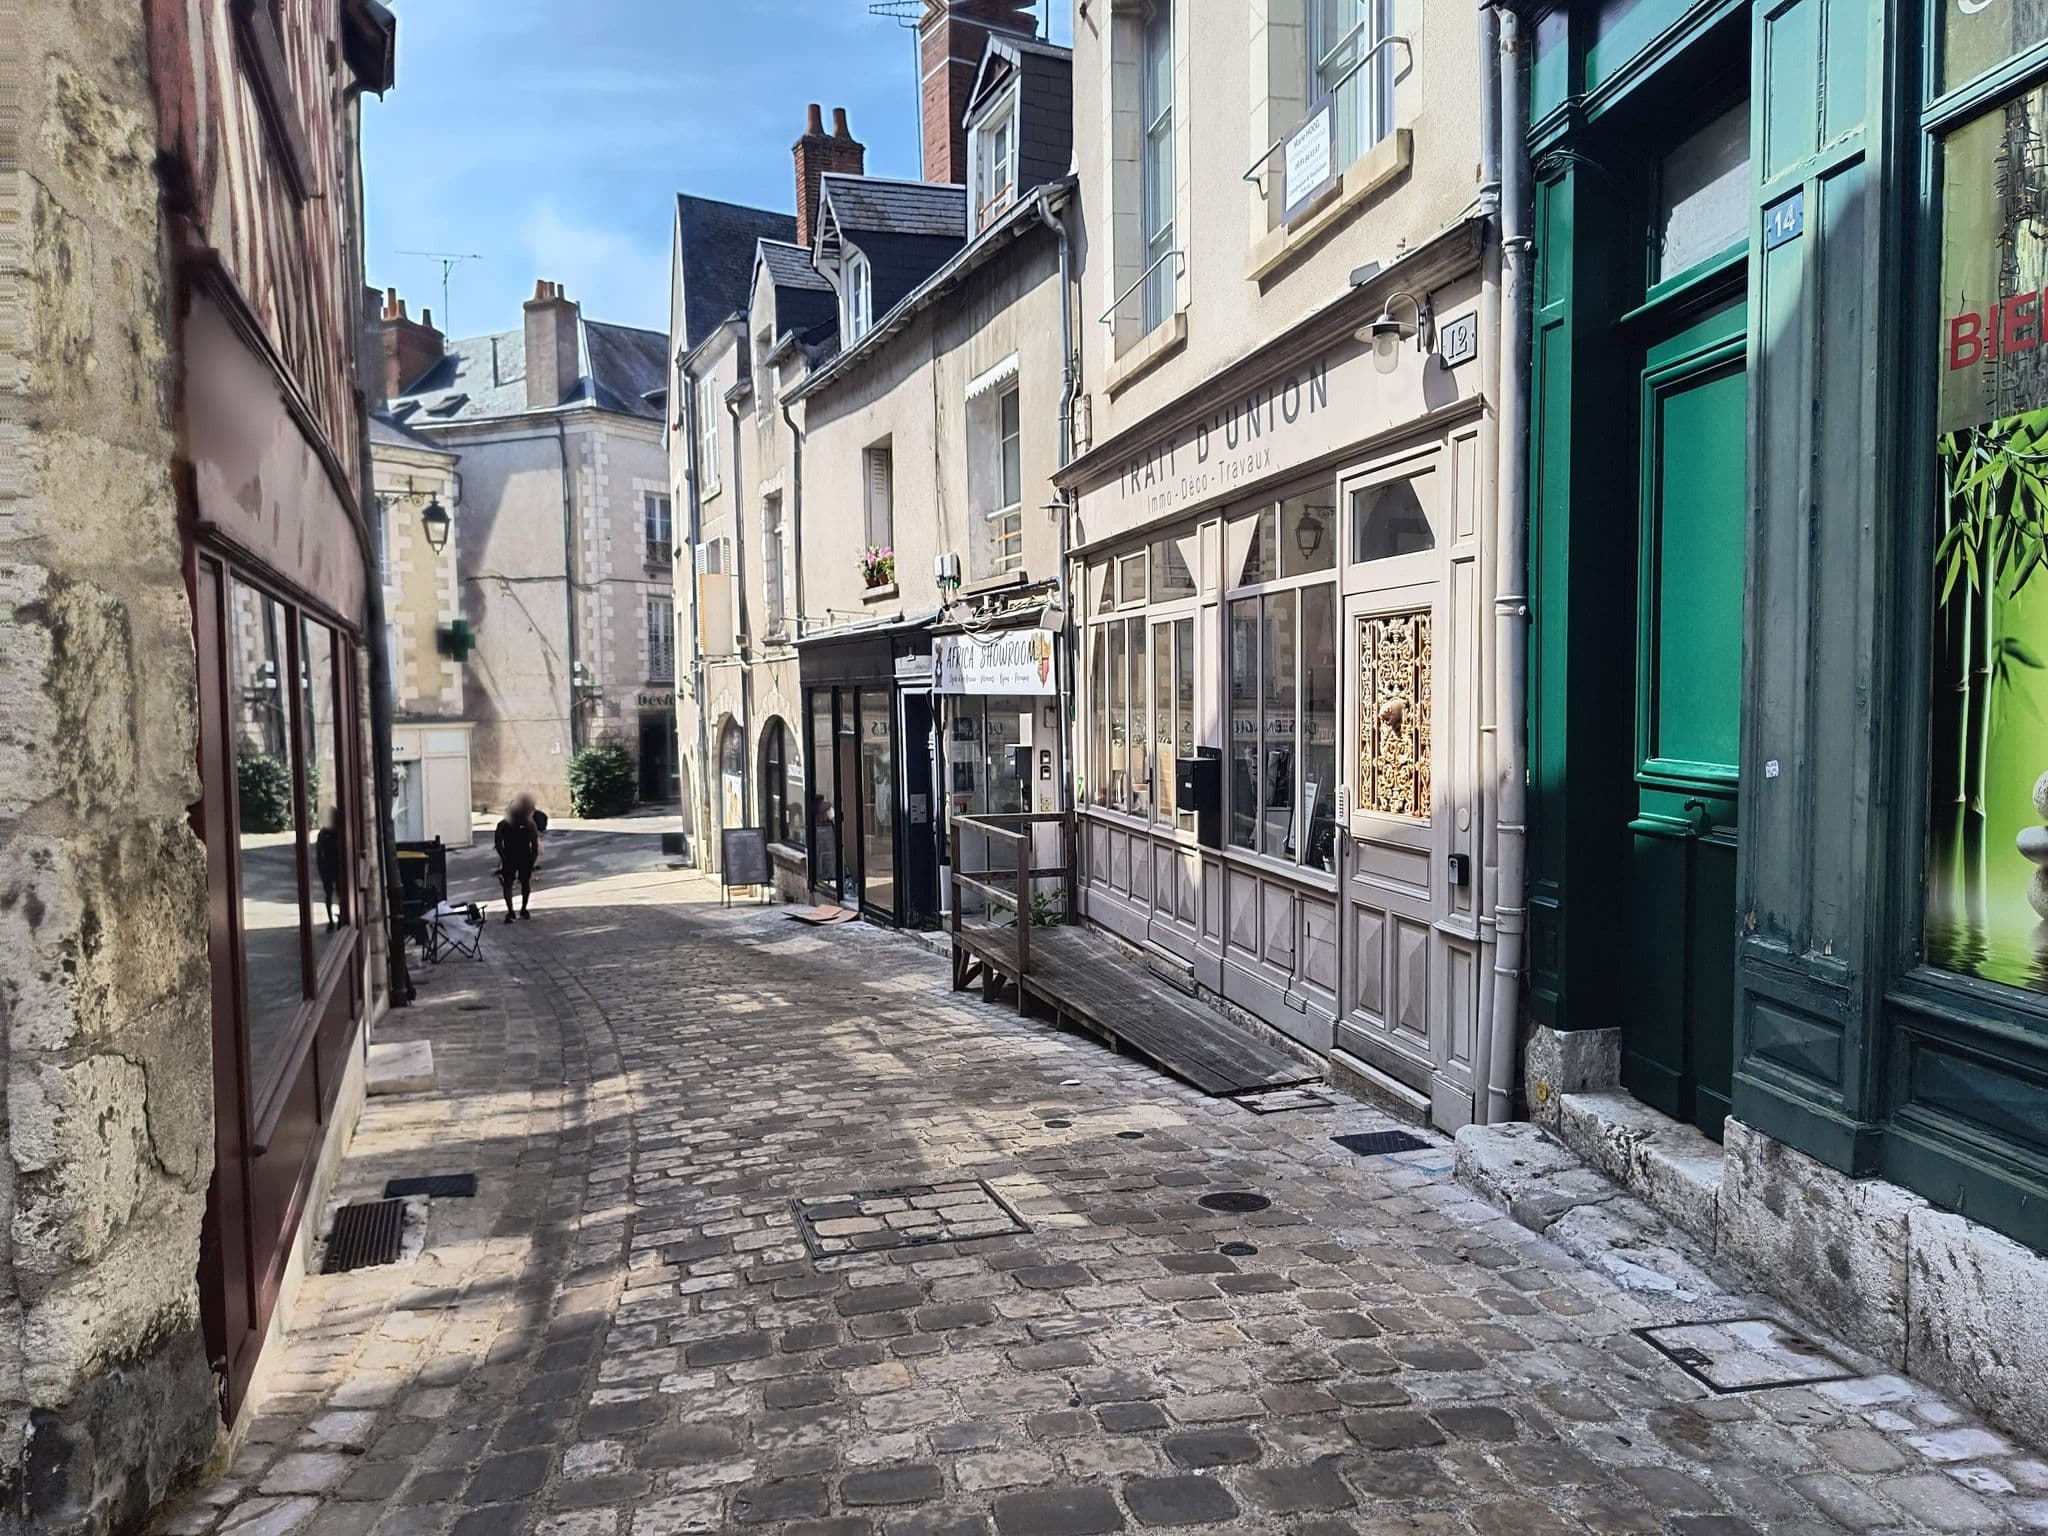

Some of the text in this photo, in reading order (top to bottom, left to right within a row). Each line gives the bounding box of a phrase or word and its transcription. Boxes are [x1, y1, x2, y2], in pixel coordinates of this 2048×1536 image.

[1774, 204, 1796, 238] 14
[1448, 325, 1468, 359] 12
[1950, 286, 2048, 372] BIE
[1118, 358, 1328, 500] TRAIT D'UNION
[1181, 474, 1208, 500] Déco
[1218, 447, 1270, 484] Travaux
[946, 640, 1036, 669] AFRICA SHOWROOM
